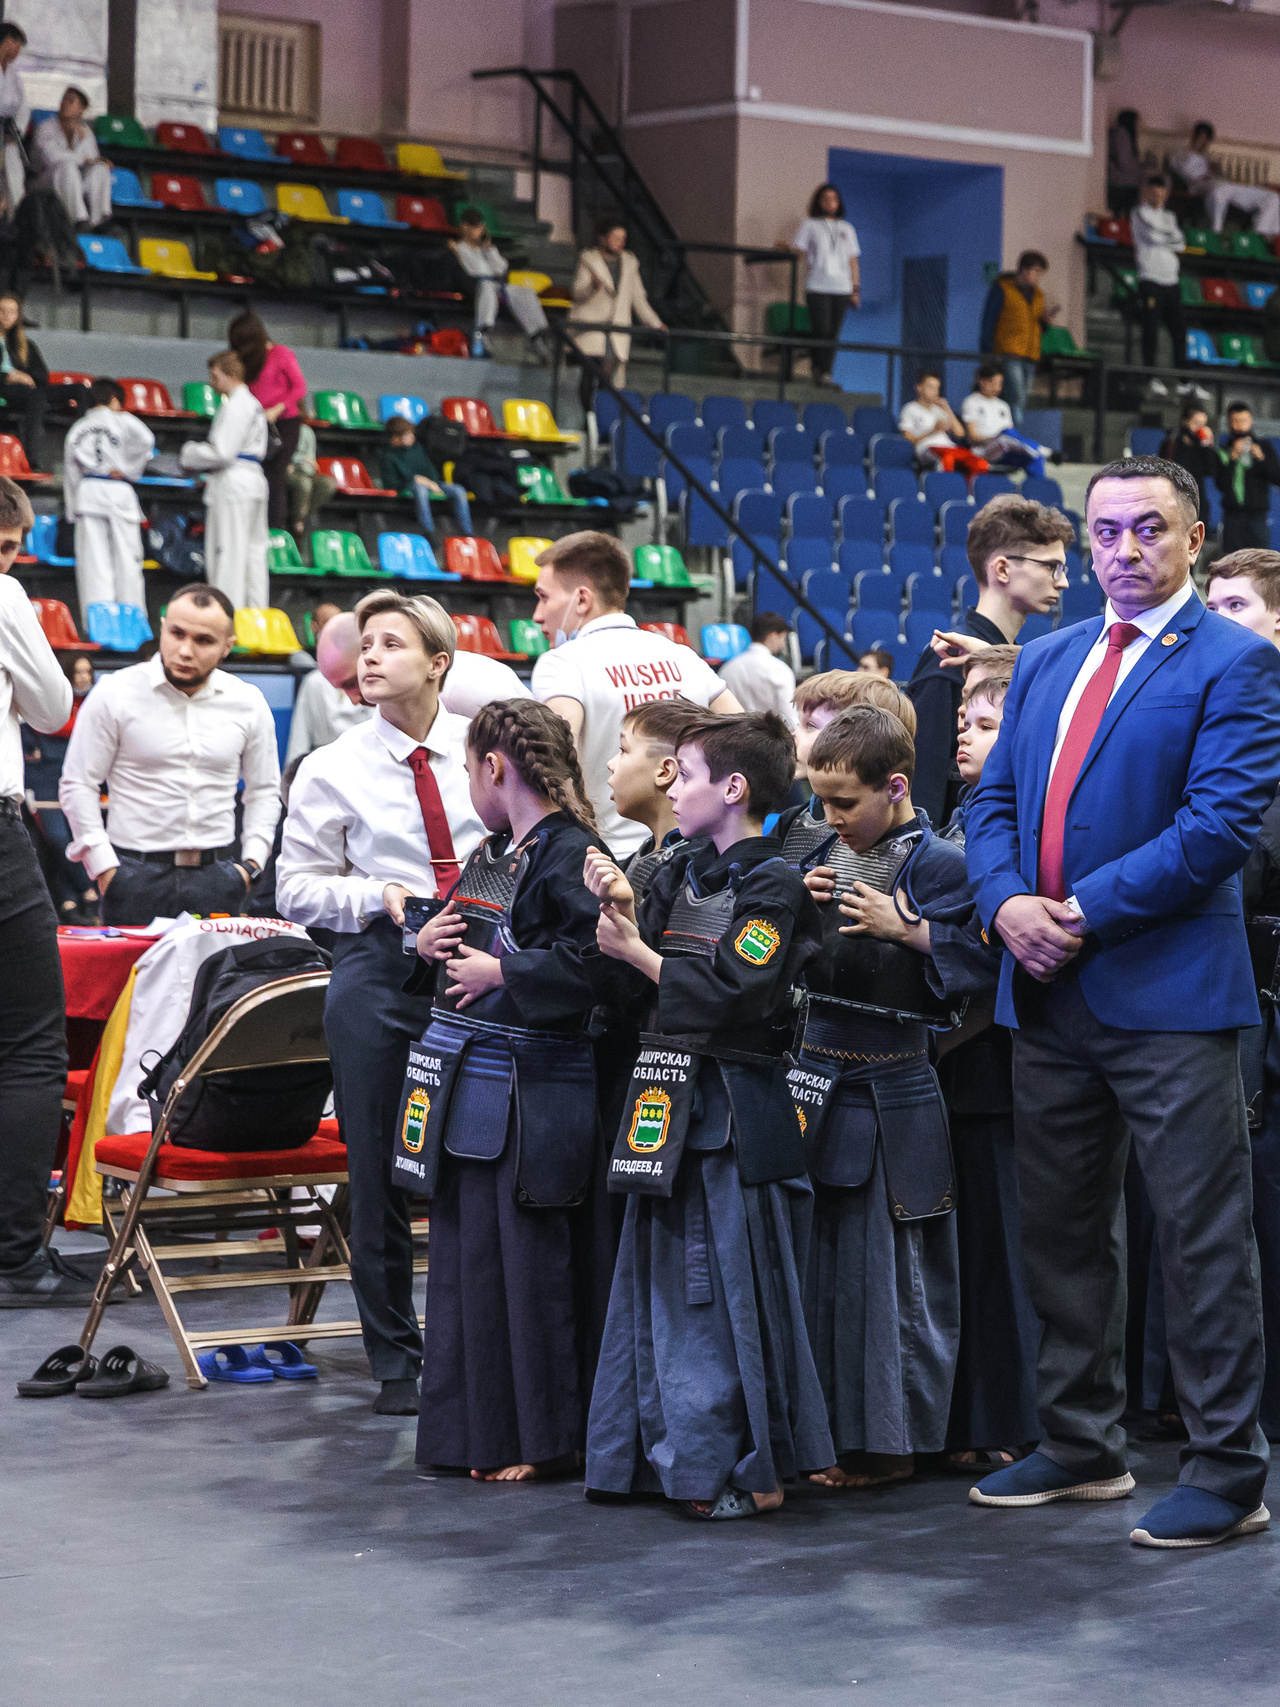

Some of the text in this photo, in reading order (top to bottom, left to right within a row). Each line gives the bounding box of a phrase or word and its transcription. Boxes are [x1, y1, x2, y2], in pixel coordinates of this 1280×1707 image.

[605, 660, 682, 688] WUSHU
[637, 1051, 691, 1067] АМУРСКАЯ
[633, 1066, 687, 1082] ОБЛАСТЬ
[788, 1084, 824, 1106] ЛАСТЬ
[612, 1159, 652, 1175] ПОЗДЕЕВ
